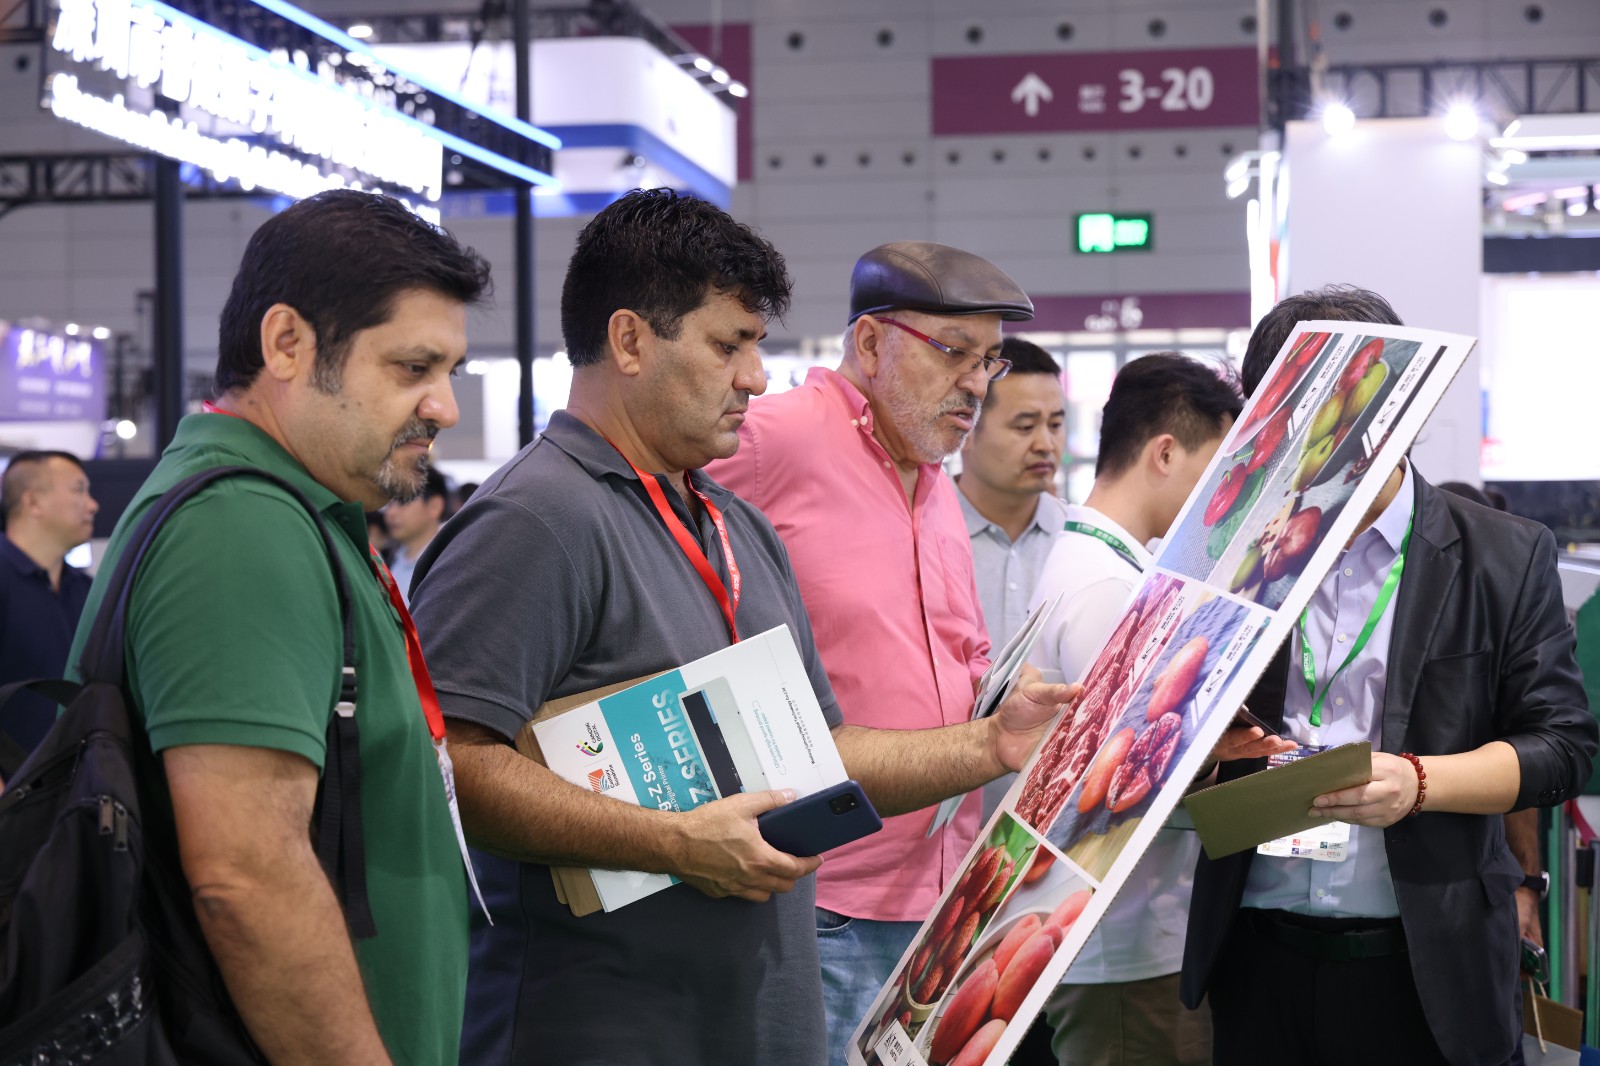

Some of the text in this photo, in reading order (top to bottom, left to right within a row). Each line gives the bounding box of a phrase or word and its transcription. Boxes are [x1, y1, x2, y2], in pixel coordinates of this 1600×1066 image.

[1118, 67, 1215, 113] 3-20
[630, 733, 657, 783] Series
[651, 689, 697, 780] SERIES
[658, 765, 668, 786] Printer
